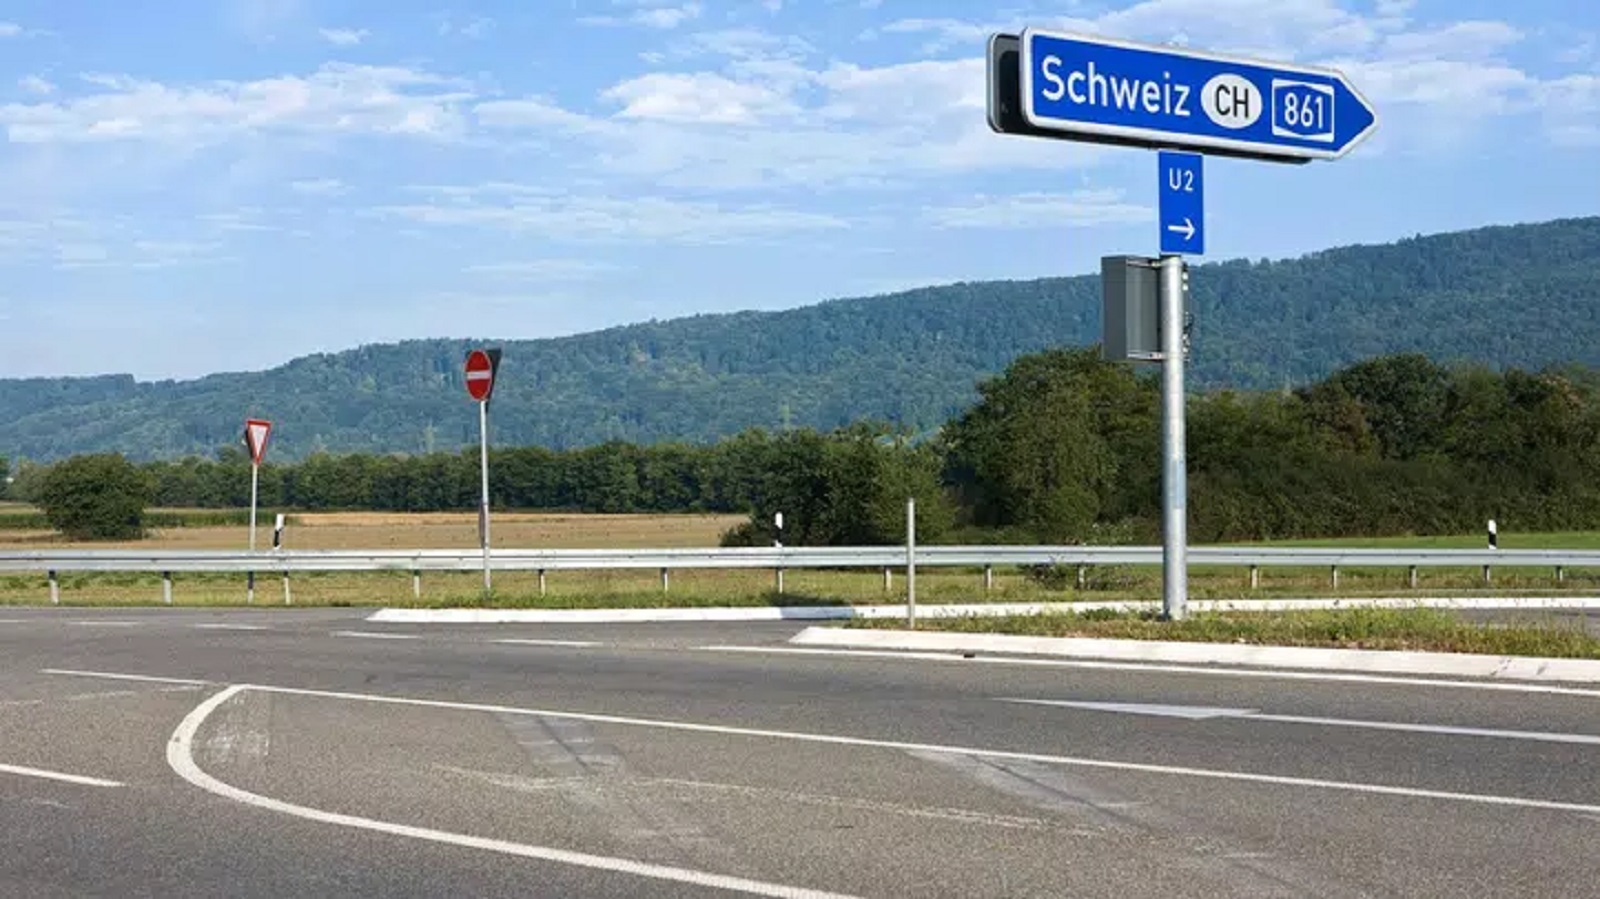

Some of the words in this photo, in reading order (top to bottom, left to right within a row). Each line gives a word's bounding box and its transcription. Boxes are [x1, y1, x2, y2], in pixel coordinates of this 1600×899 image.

[1041, 55, 1191, 117] Schweiz
[1216, 84, 1249, 118] CH
[1284, 92, 1324, 129] 861
